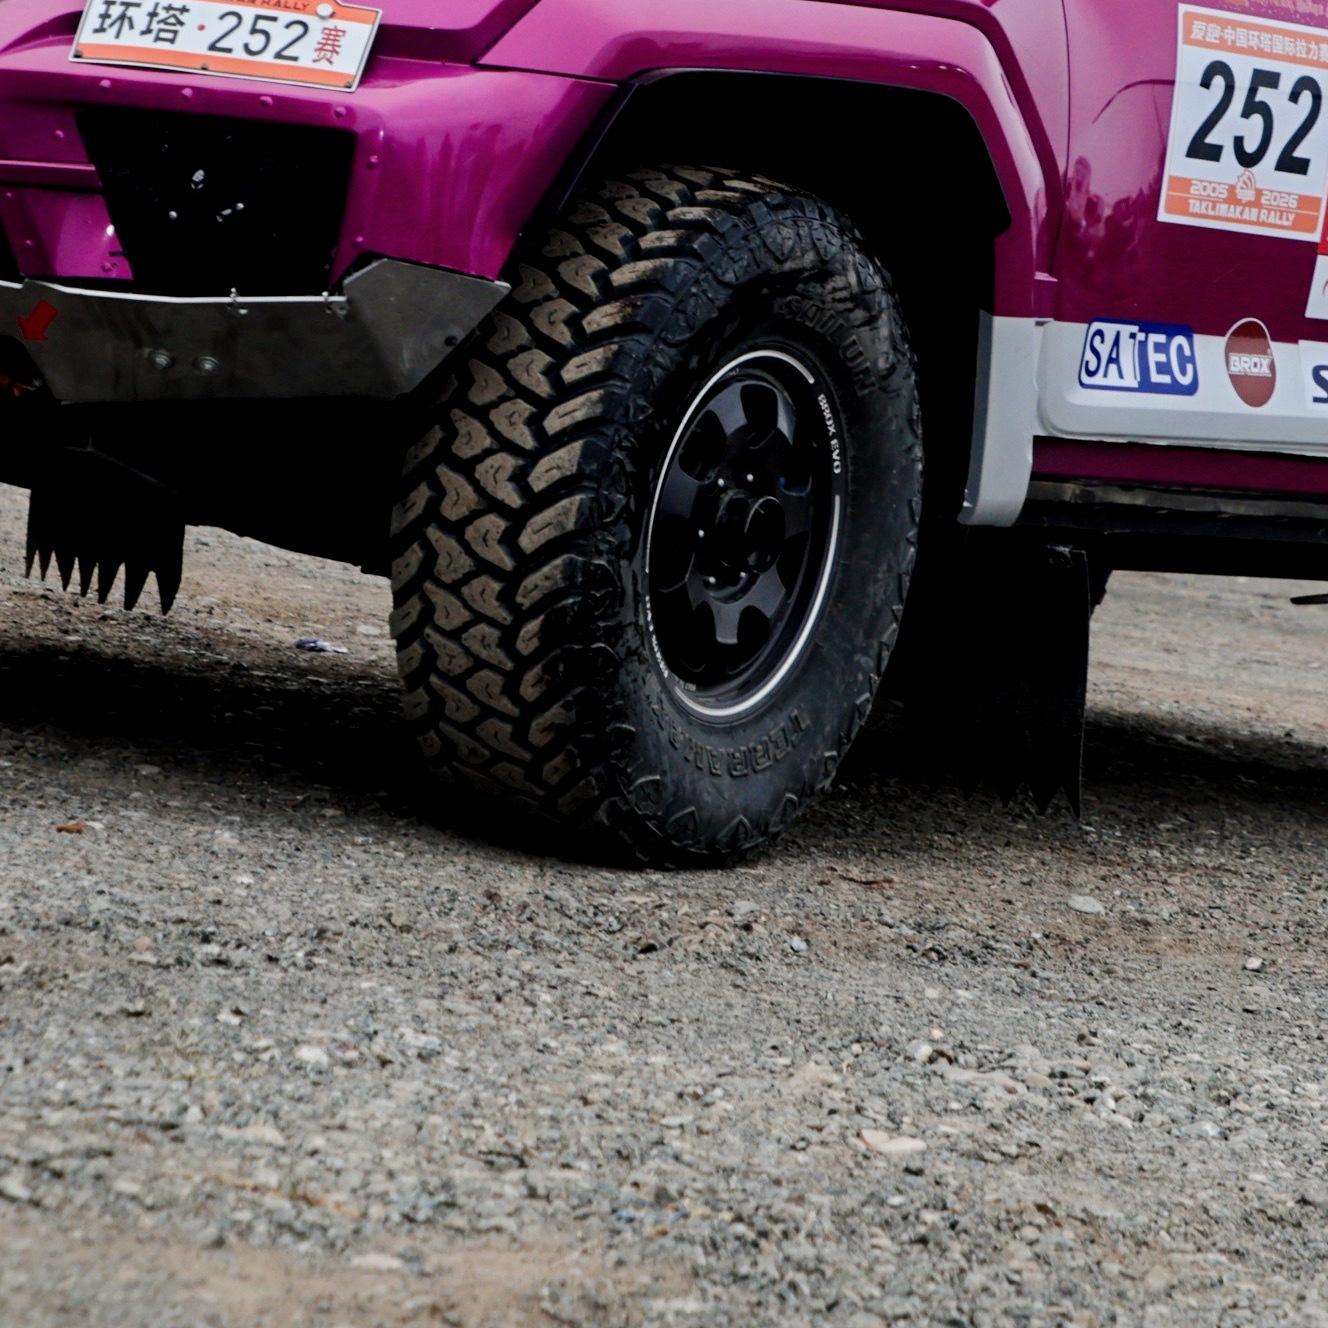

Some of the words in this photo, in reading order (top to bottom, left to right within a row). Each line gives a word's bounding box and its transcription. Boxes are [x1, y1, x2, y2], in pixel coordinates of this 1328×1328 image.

[1184, 60, 1323, 176] 252
[1188, 199, 1259, 222] TAKLIMAKAN
[1258, 209, 1296, 226] RALLY
[1189, 180, 1229, 199] 2005
[1260, 190, 1299, 209] 2026
[1083, 327, 1193, 386] SATEC
[816, 392, 837, 436] BROX
[829, 438, 842, 475] EVO
